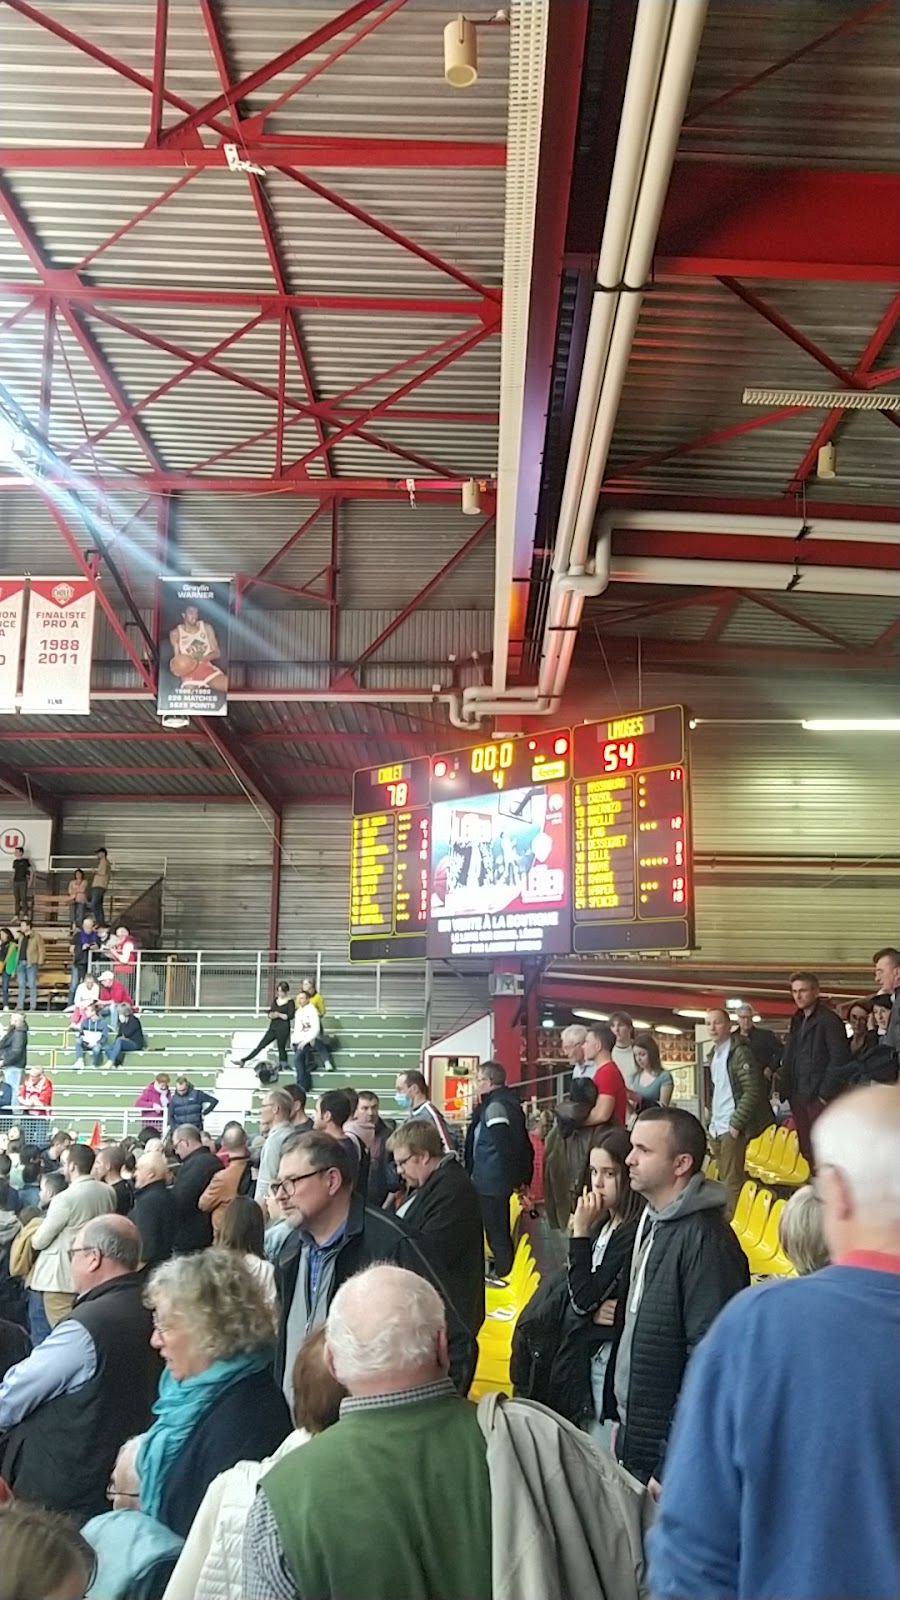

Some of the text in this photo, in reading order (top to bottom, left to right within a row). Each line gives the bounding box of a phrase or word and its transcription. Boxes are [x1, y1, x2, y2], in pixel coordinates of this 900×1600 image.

[182, 584, 209, 593] Graylin
[177, 591, 214, 599] WARNER
[36, 611, 87, 619] FINALISTE
[43, 620, 79, 628] PRO A
[39, 639, 80, 651] 1988
[38, 653, 78, 665] 2011
[184, 694, 218, 702] MATCHES
[608, 716, 644, 741] LIMOGES
[604, 742, 635, 772] 54
[491, 770, 505, 789] 4
[670, 769, 681, 781] 11
[386, 782, 408, 807] 78
[5, 835, 19, 848] U
[482, 913, 491, 929] À
[492, 915, 506, 929] LA
[506, 911, 559, 928] BOUTIQUE
